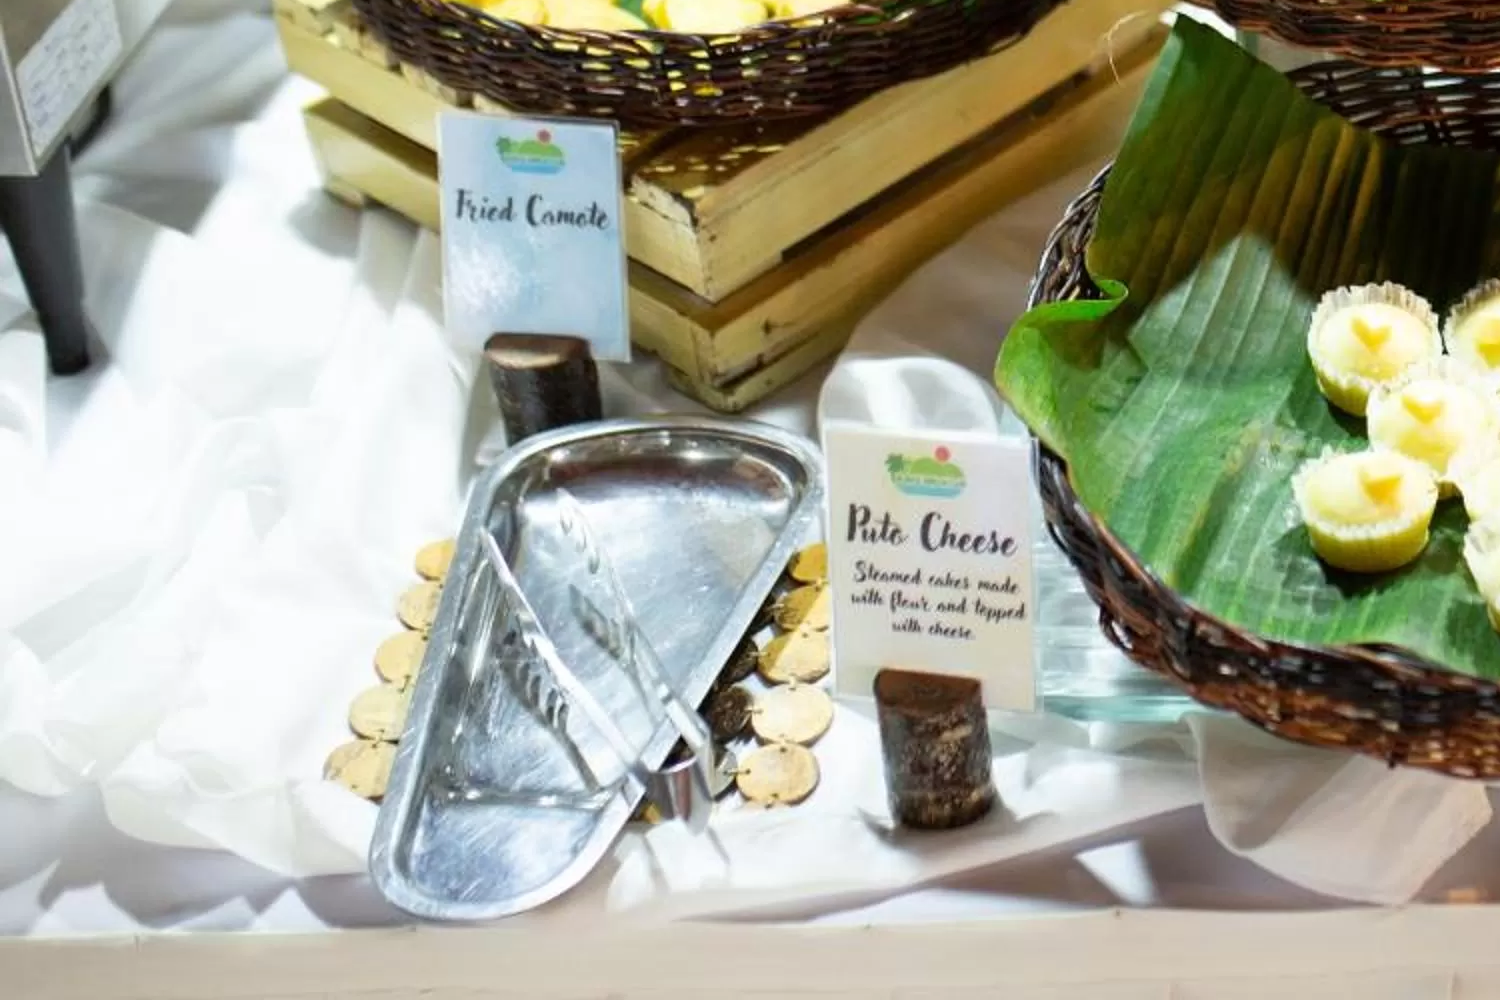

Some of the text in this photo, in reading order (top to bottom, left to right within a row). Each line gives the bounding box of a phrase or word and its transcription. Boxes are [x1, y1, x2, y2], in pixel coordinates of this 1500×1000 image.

[456, 188, 609, 230] Fried Camote
[847, 503, 1017, 557] Puto Cheese
[854, 560, 1019, 594] Steamed cakes made
[851, 588, 1026, 623] with flour and topped
[892, 618, 922, 633] with
